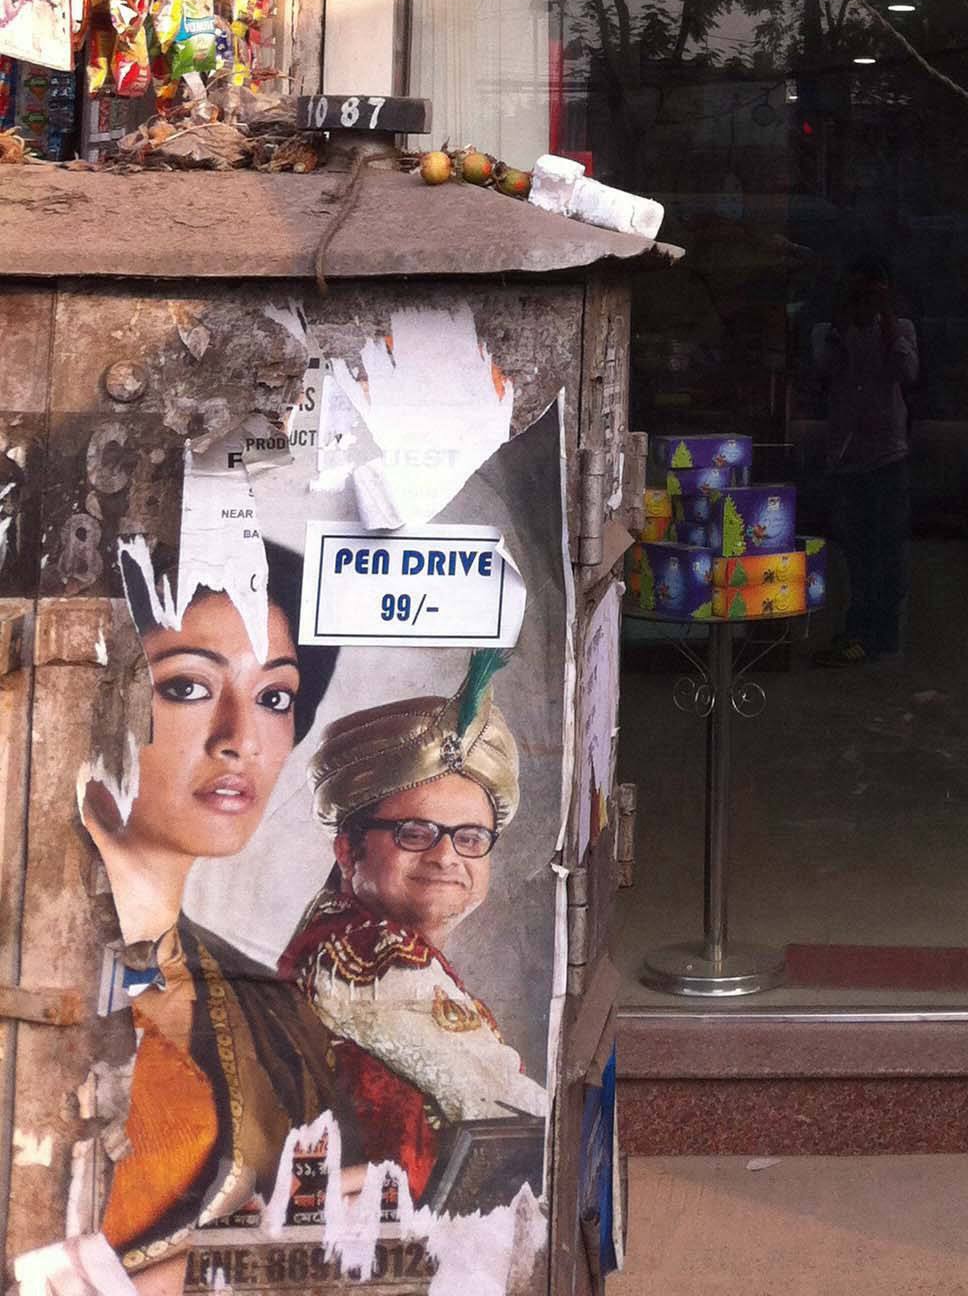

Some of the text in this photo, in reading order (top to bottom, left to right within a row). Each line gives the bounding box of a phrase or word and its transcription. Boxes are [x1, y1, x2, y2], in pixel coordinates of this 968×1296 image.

[221, 509, 254, 519] NEAR
[334, 548, 493, 577] PEN DRIVE
[380, 593, 440, 626] 99/-
